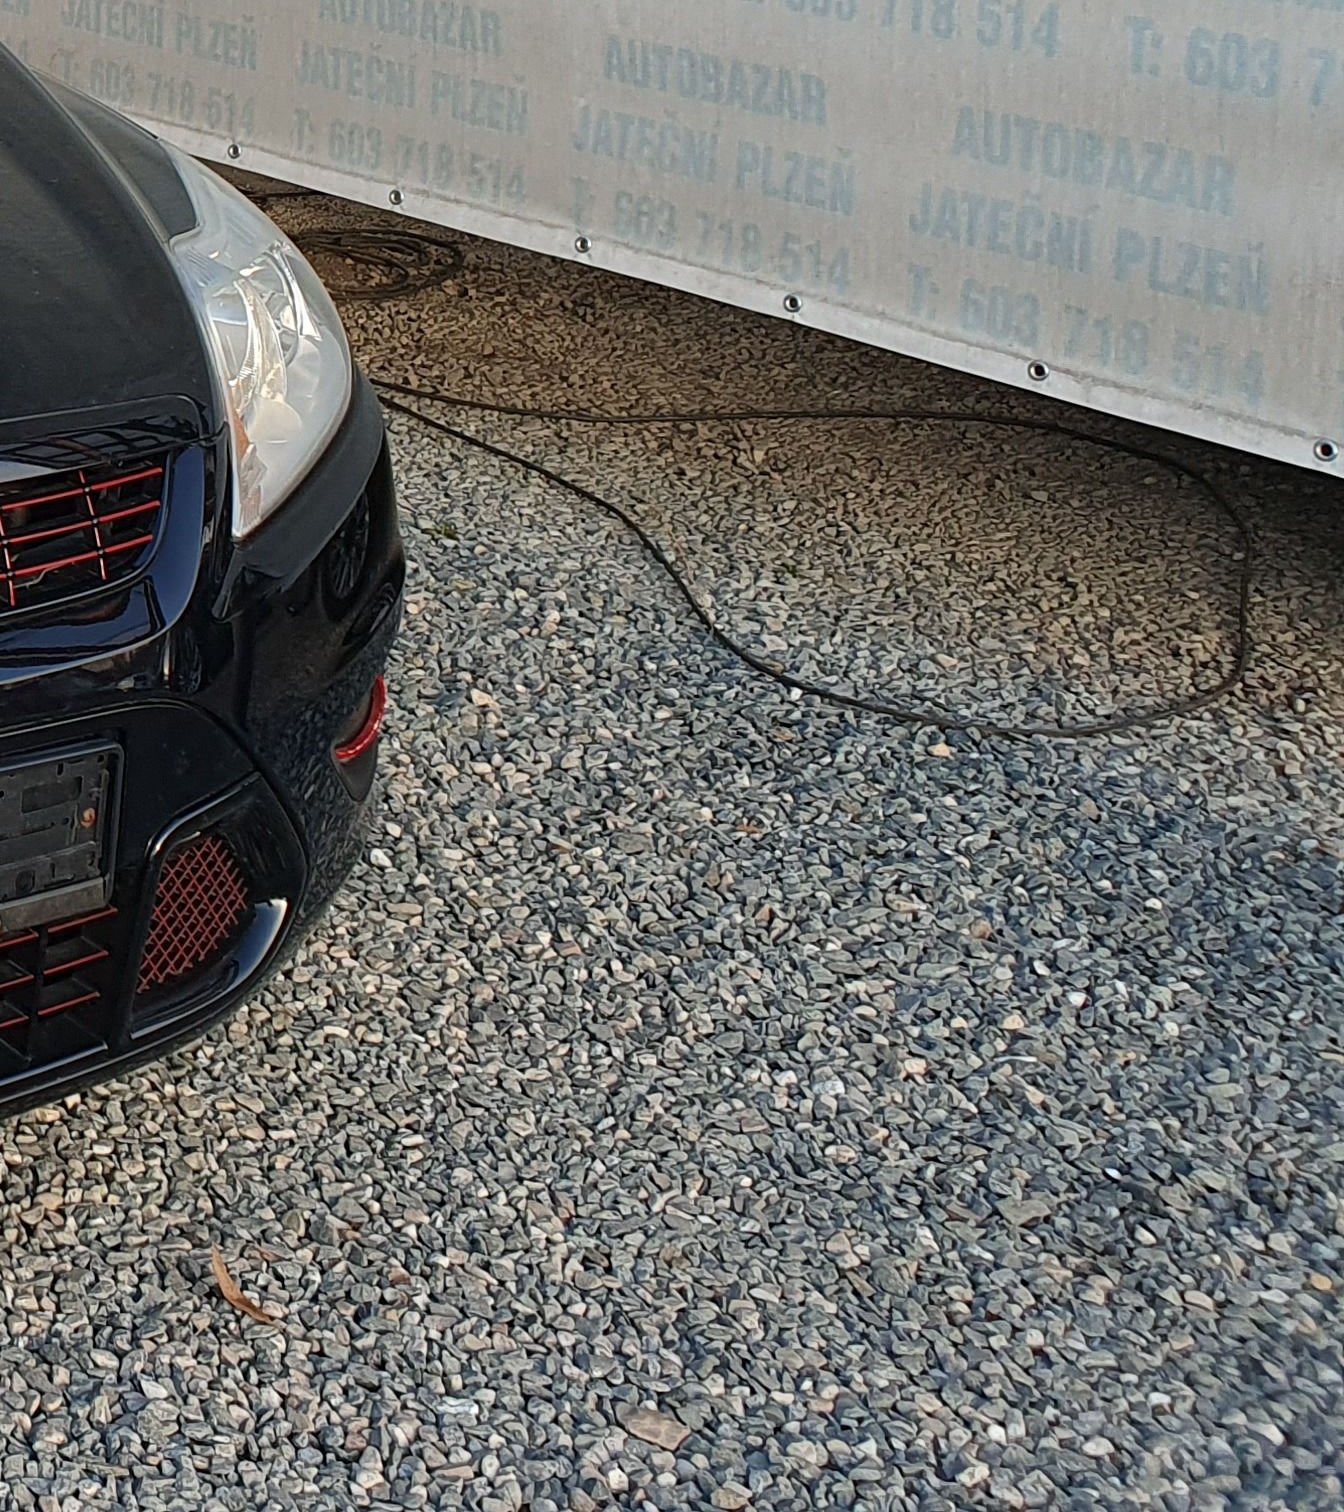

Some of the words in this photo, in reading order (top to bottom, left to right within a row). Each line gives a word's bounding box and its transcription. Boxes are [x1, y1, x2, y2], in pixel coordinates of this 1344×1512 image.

[176, 13, 257, 72] PLZEŇ
[601, 34, 827, 128] AUTOBAZAR
[431, 70, 528, 137] PLZEŇ
[735, 141, 856, 218] PLZEŇ
[950, 105, 1234, 216] AUTOBAZAR
[1116, 228, 1268, 317] PLZEŇ
